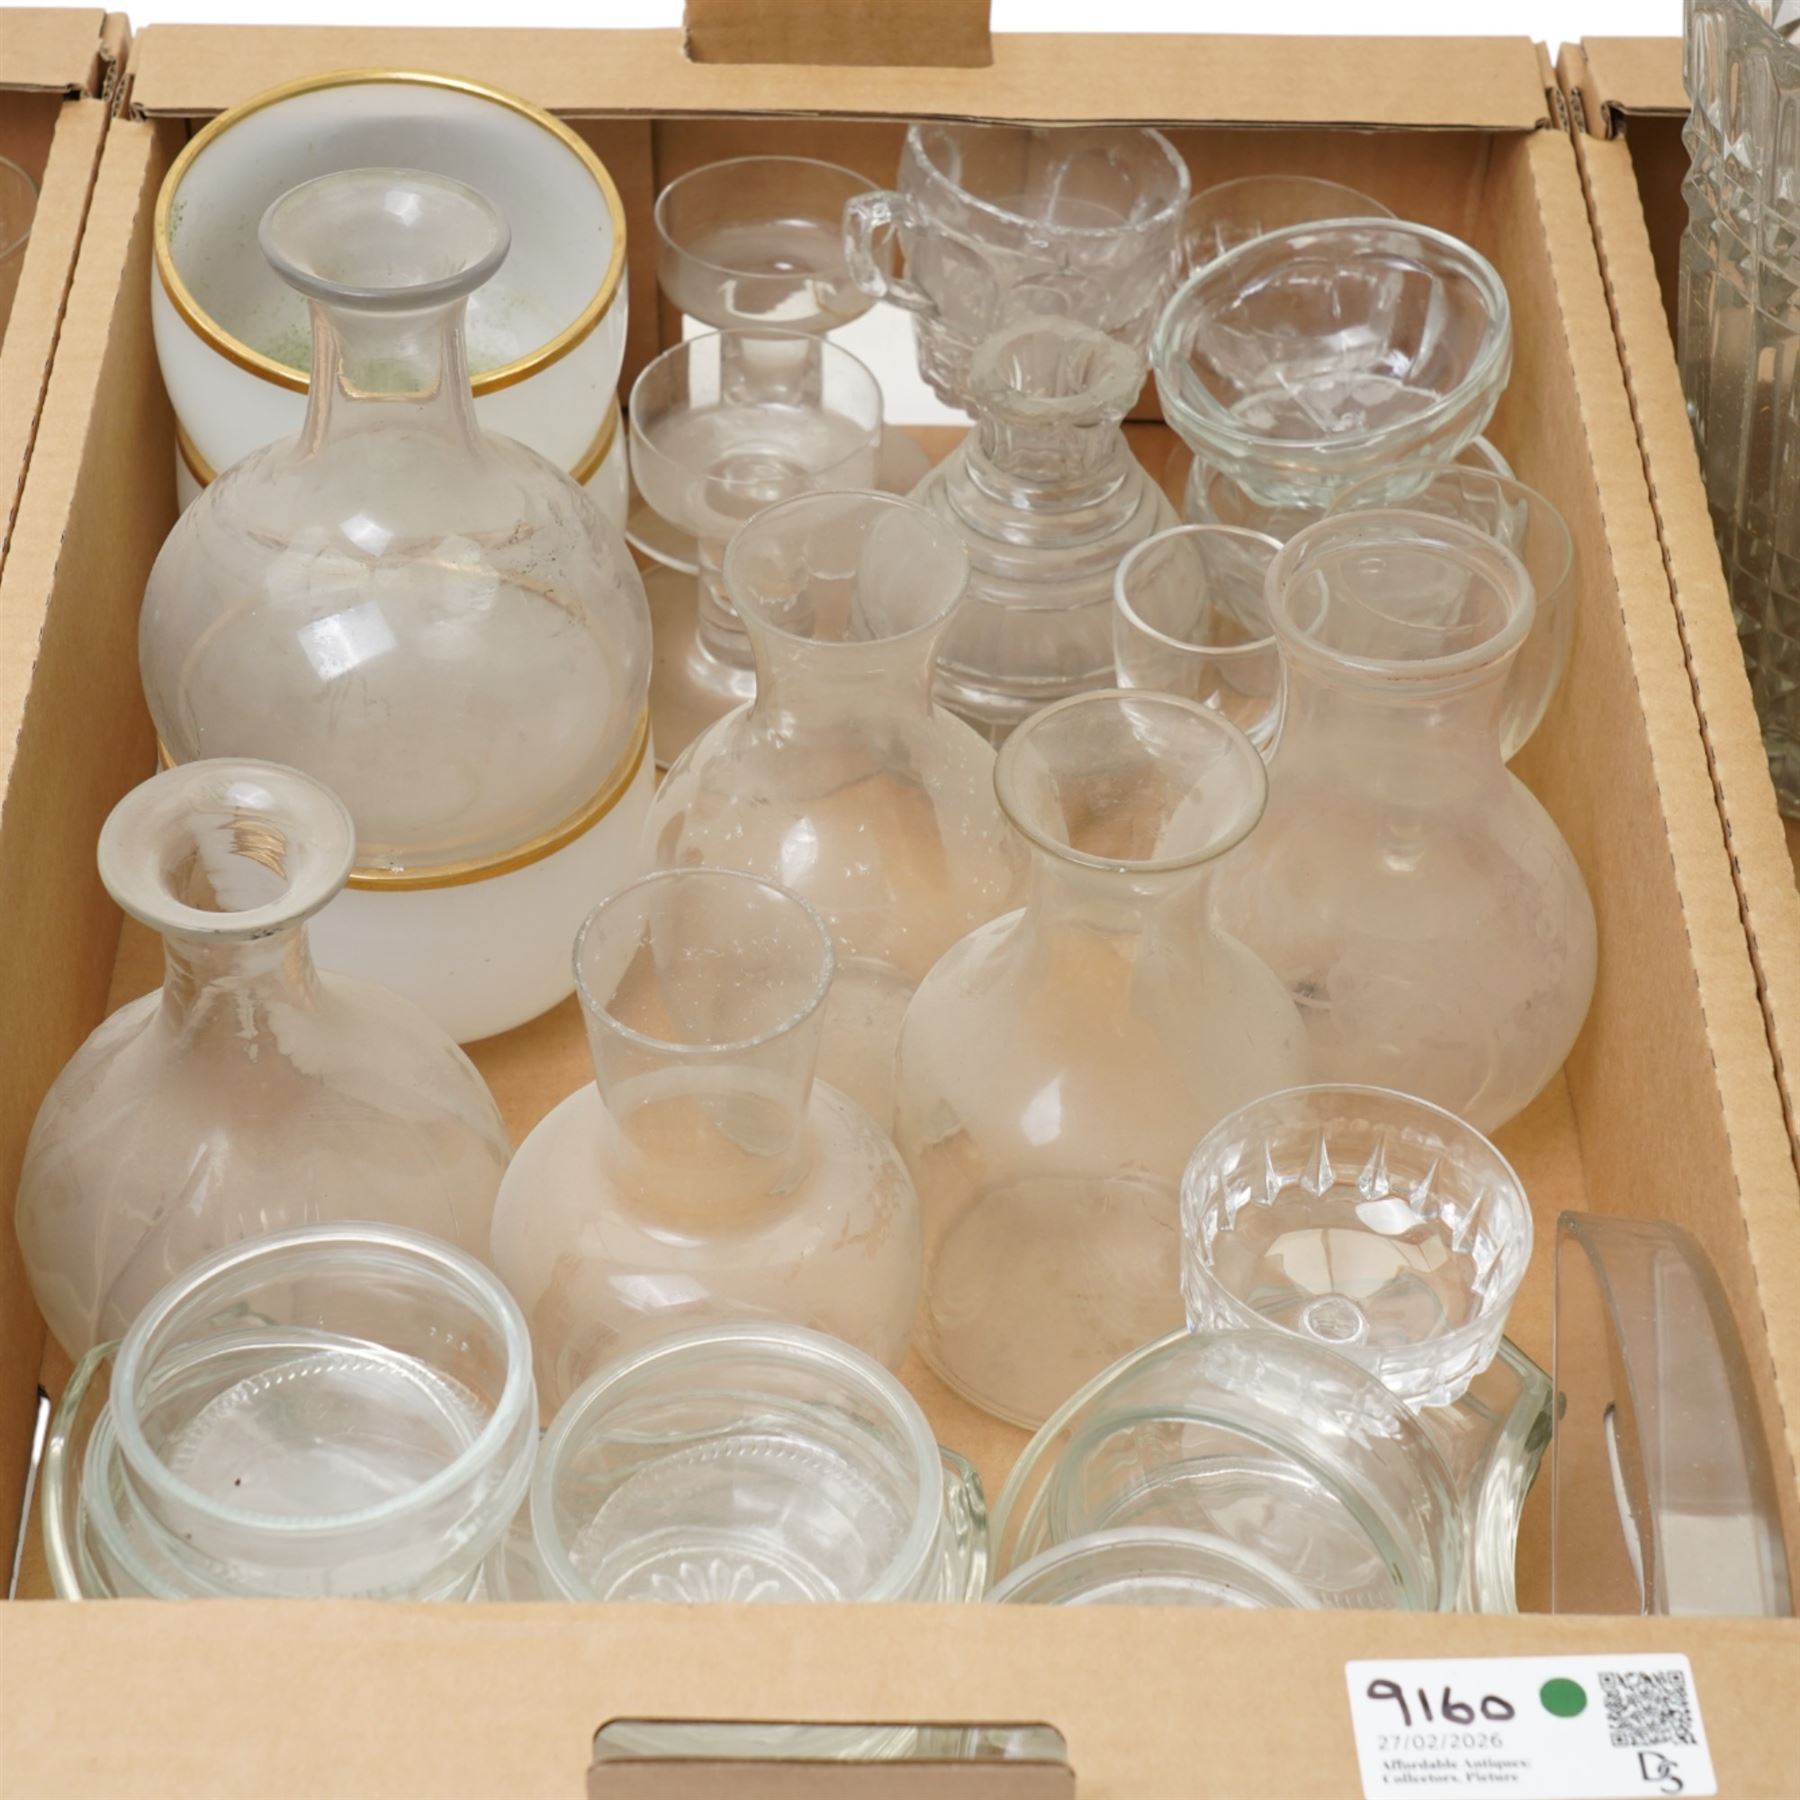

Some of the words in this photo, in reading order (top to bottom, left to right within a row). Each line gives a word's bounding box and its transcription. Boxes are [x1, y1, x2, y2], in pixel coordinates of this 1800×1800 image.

[1367, 1679, 1516, 1726] 9160
[1378, 1733, 1504, 1751] 27/02/2026
[1383, 1758, 1458, 1770] Affordable
